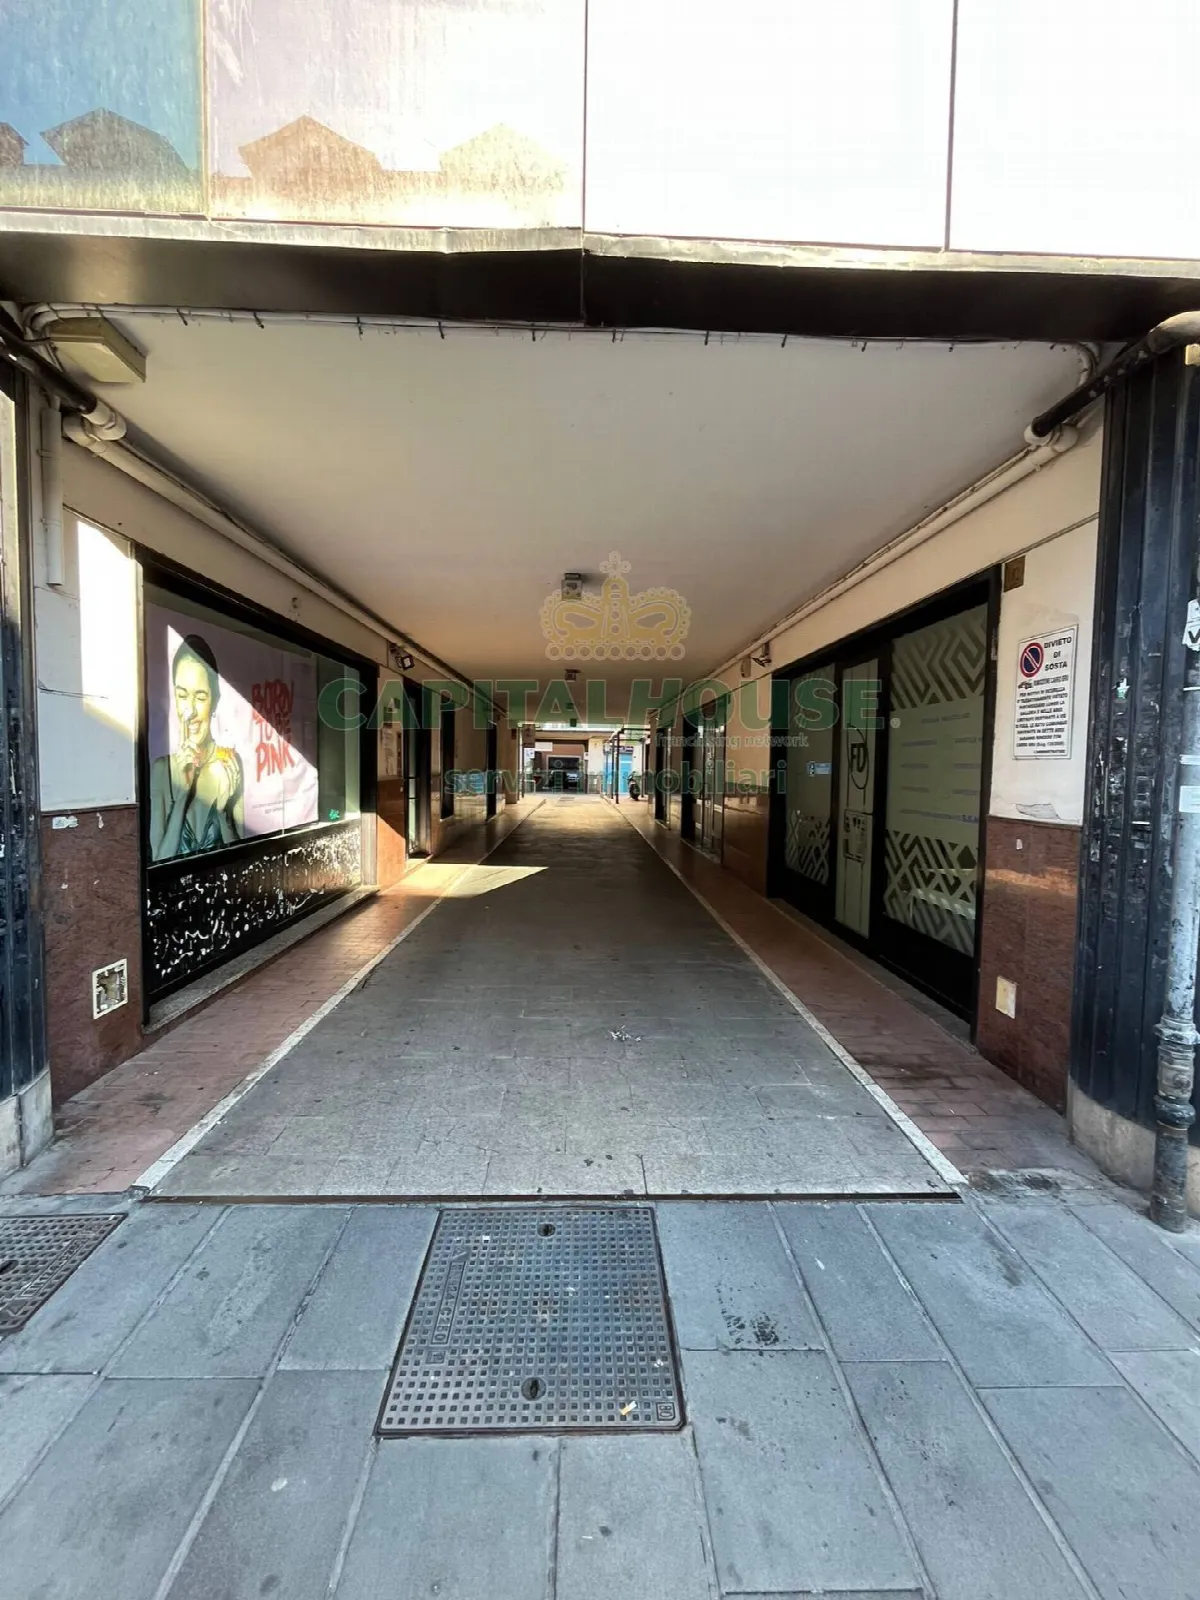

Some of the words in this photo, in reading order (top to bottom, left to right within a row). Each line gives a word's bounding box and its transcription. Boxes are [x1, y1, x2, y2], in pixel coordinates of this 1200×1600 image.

[1044, 636, 1073, 649] DIVIETO
[1053, 650, 1062, 659] DI
[1044, 660, 1068, 672] SOSTA
[255, 736, 296, 782] PINK
